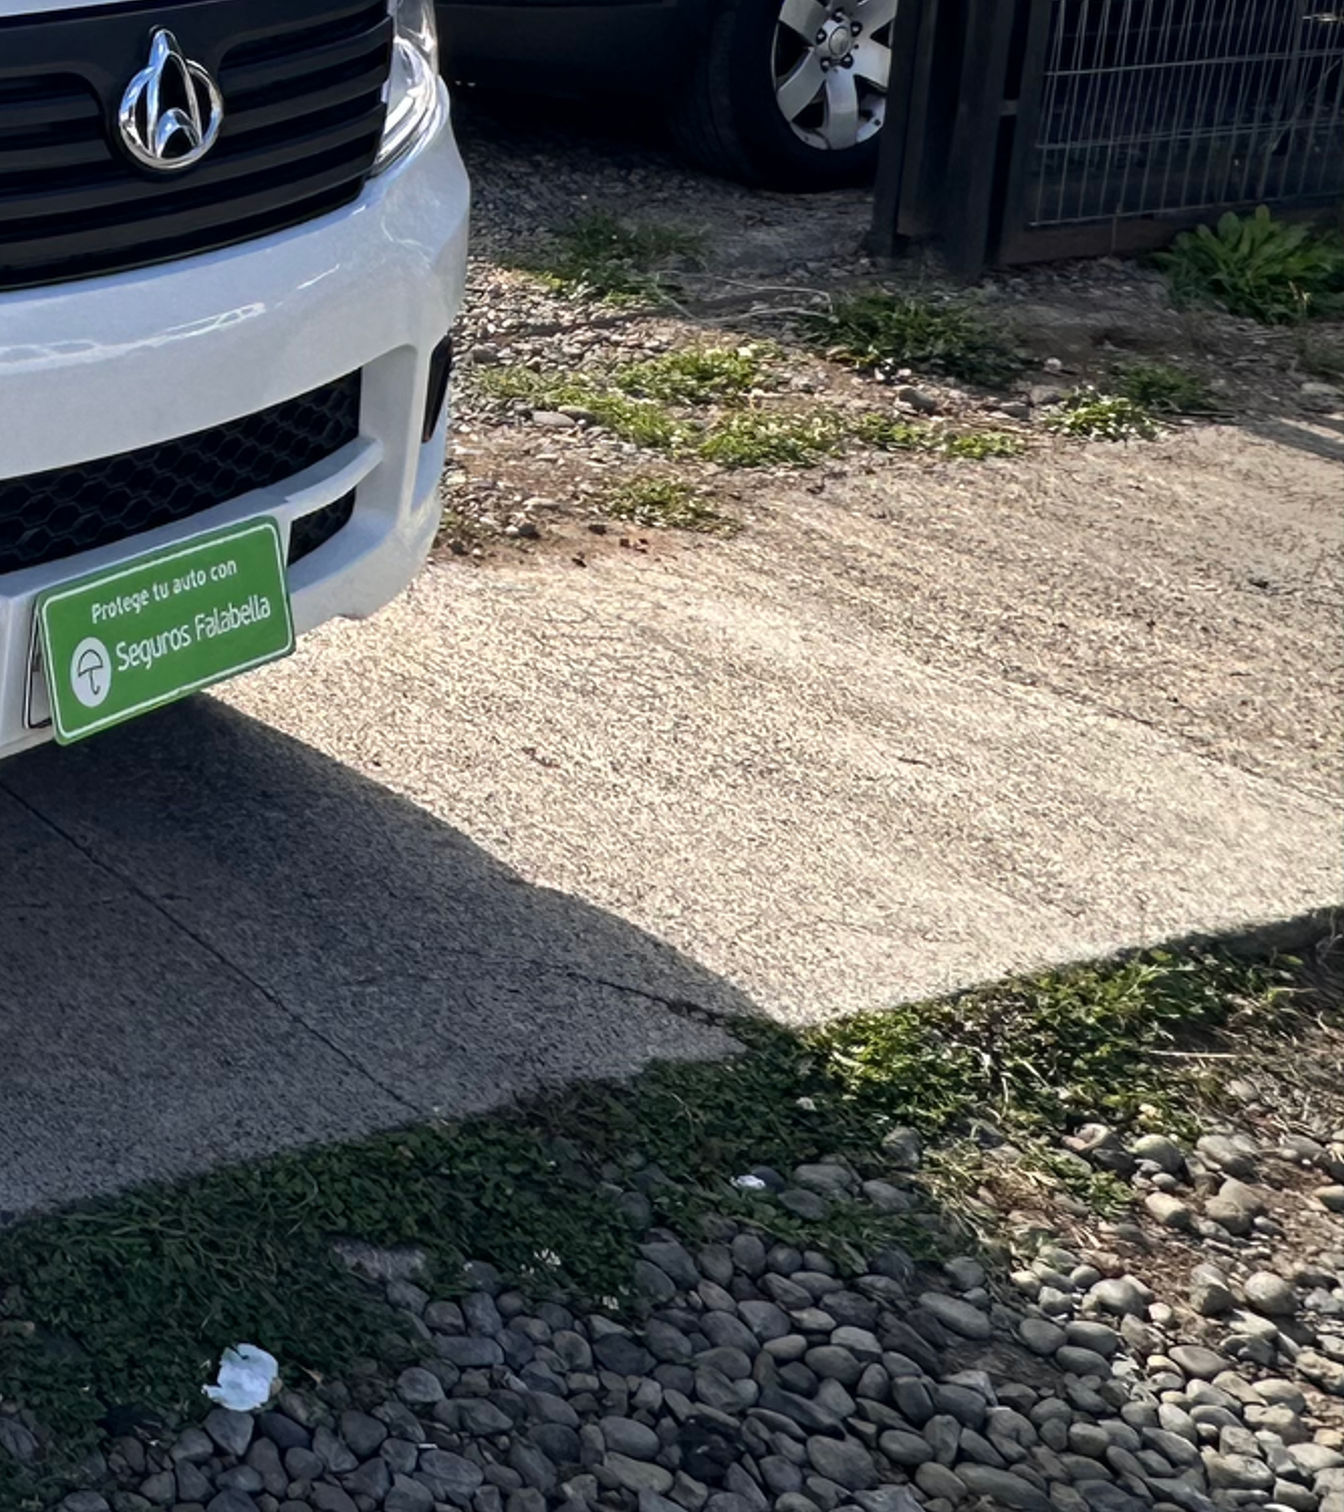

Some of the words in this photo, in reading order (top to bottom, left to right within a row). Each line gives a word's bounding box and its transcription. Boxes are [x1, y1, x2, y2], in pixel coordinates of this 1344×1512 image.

[92, 589, 149, 624] Protege
[152, 581, 169, 600] tu
[173, 568, 206, 593] auto
[210, 560, 237, 581] con
[116, 624, 191, 671] Seguros
[195, 594, 271, 640] Falabella
